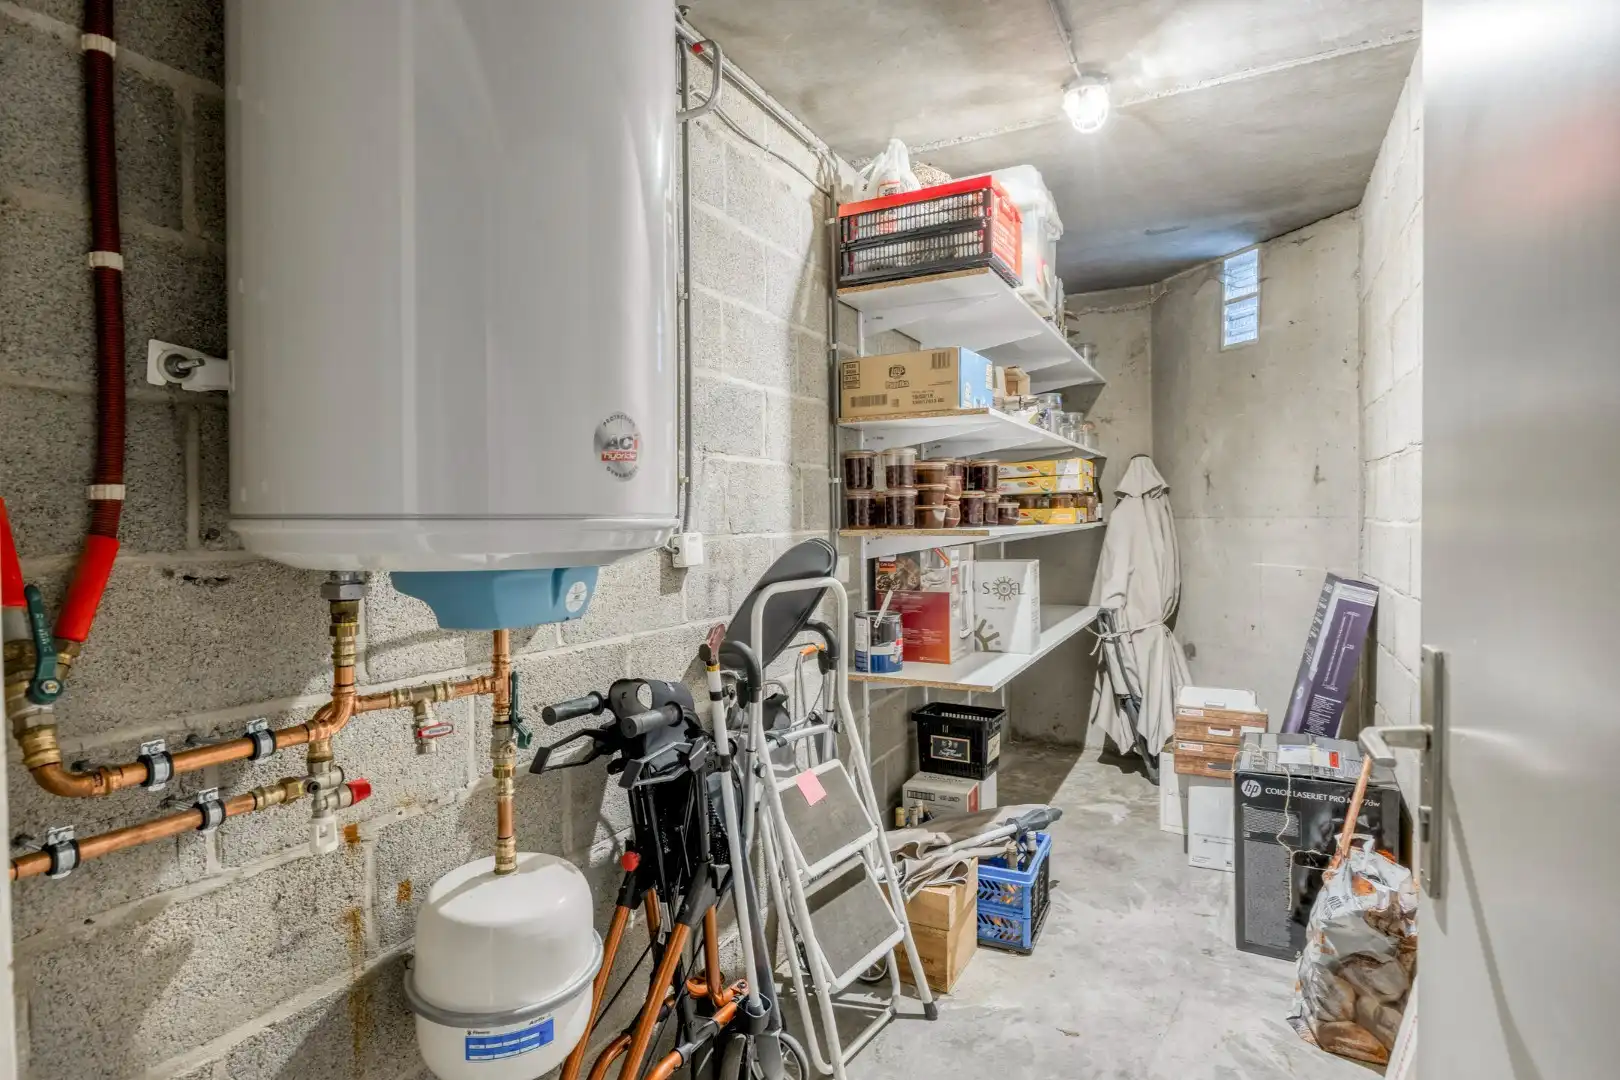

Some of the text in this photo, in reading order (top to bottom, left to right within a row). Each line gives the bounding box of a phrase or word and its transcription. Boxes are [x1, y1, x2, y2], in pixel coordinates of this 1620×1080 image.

[1244, 780, 1259, 797] hp
[1265, 787, 1292, 797] COLOR
[1292, 790, 1328, 801] LASERJET
[1328, 794, 1346, 804] PRO
